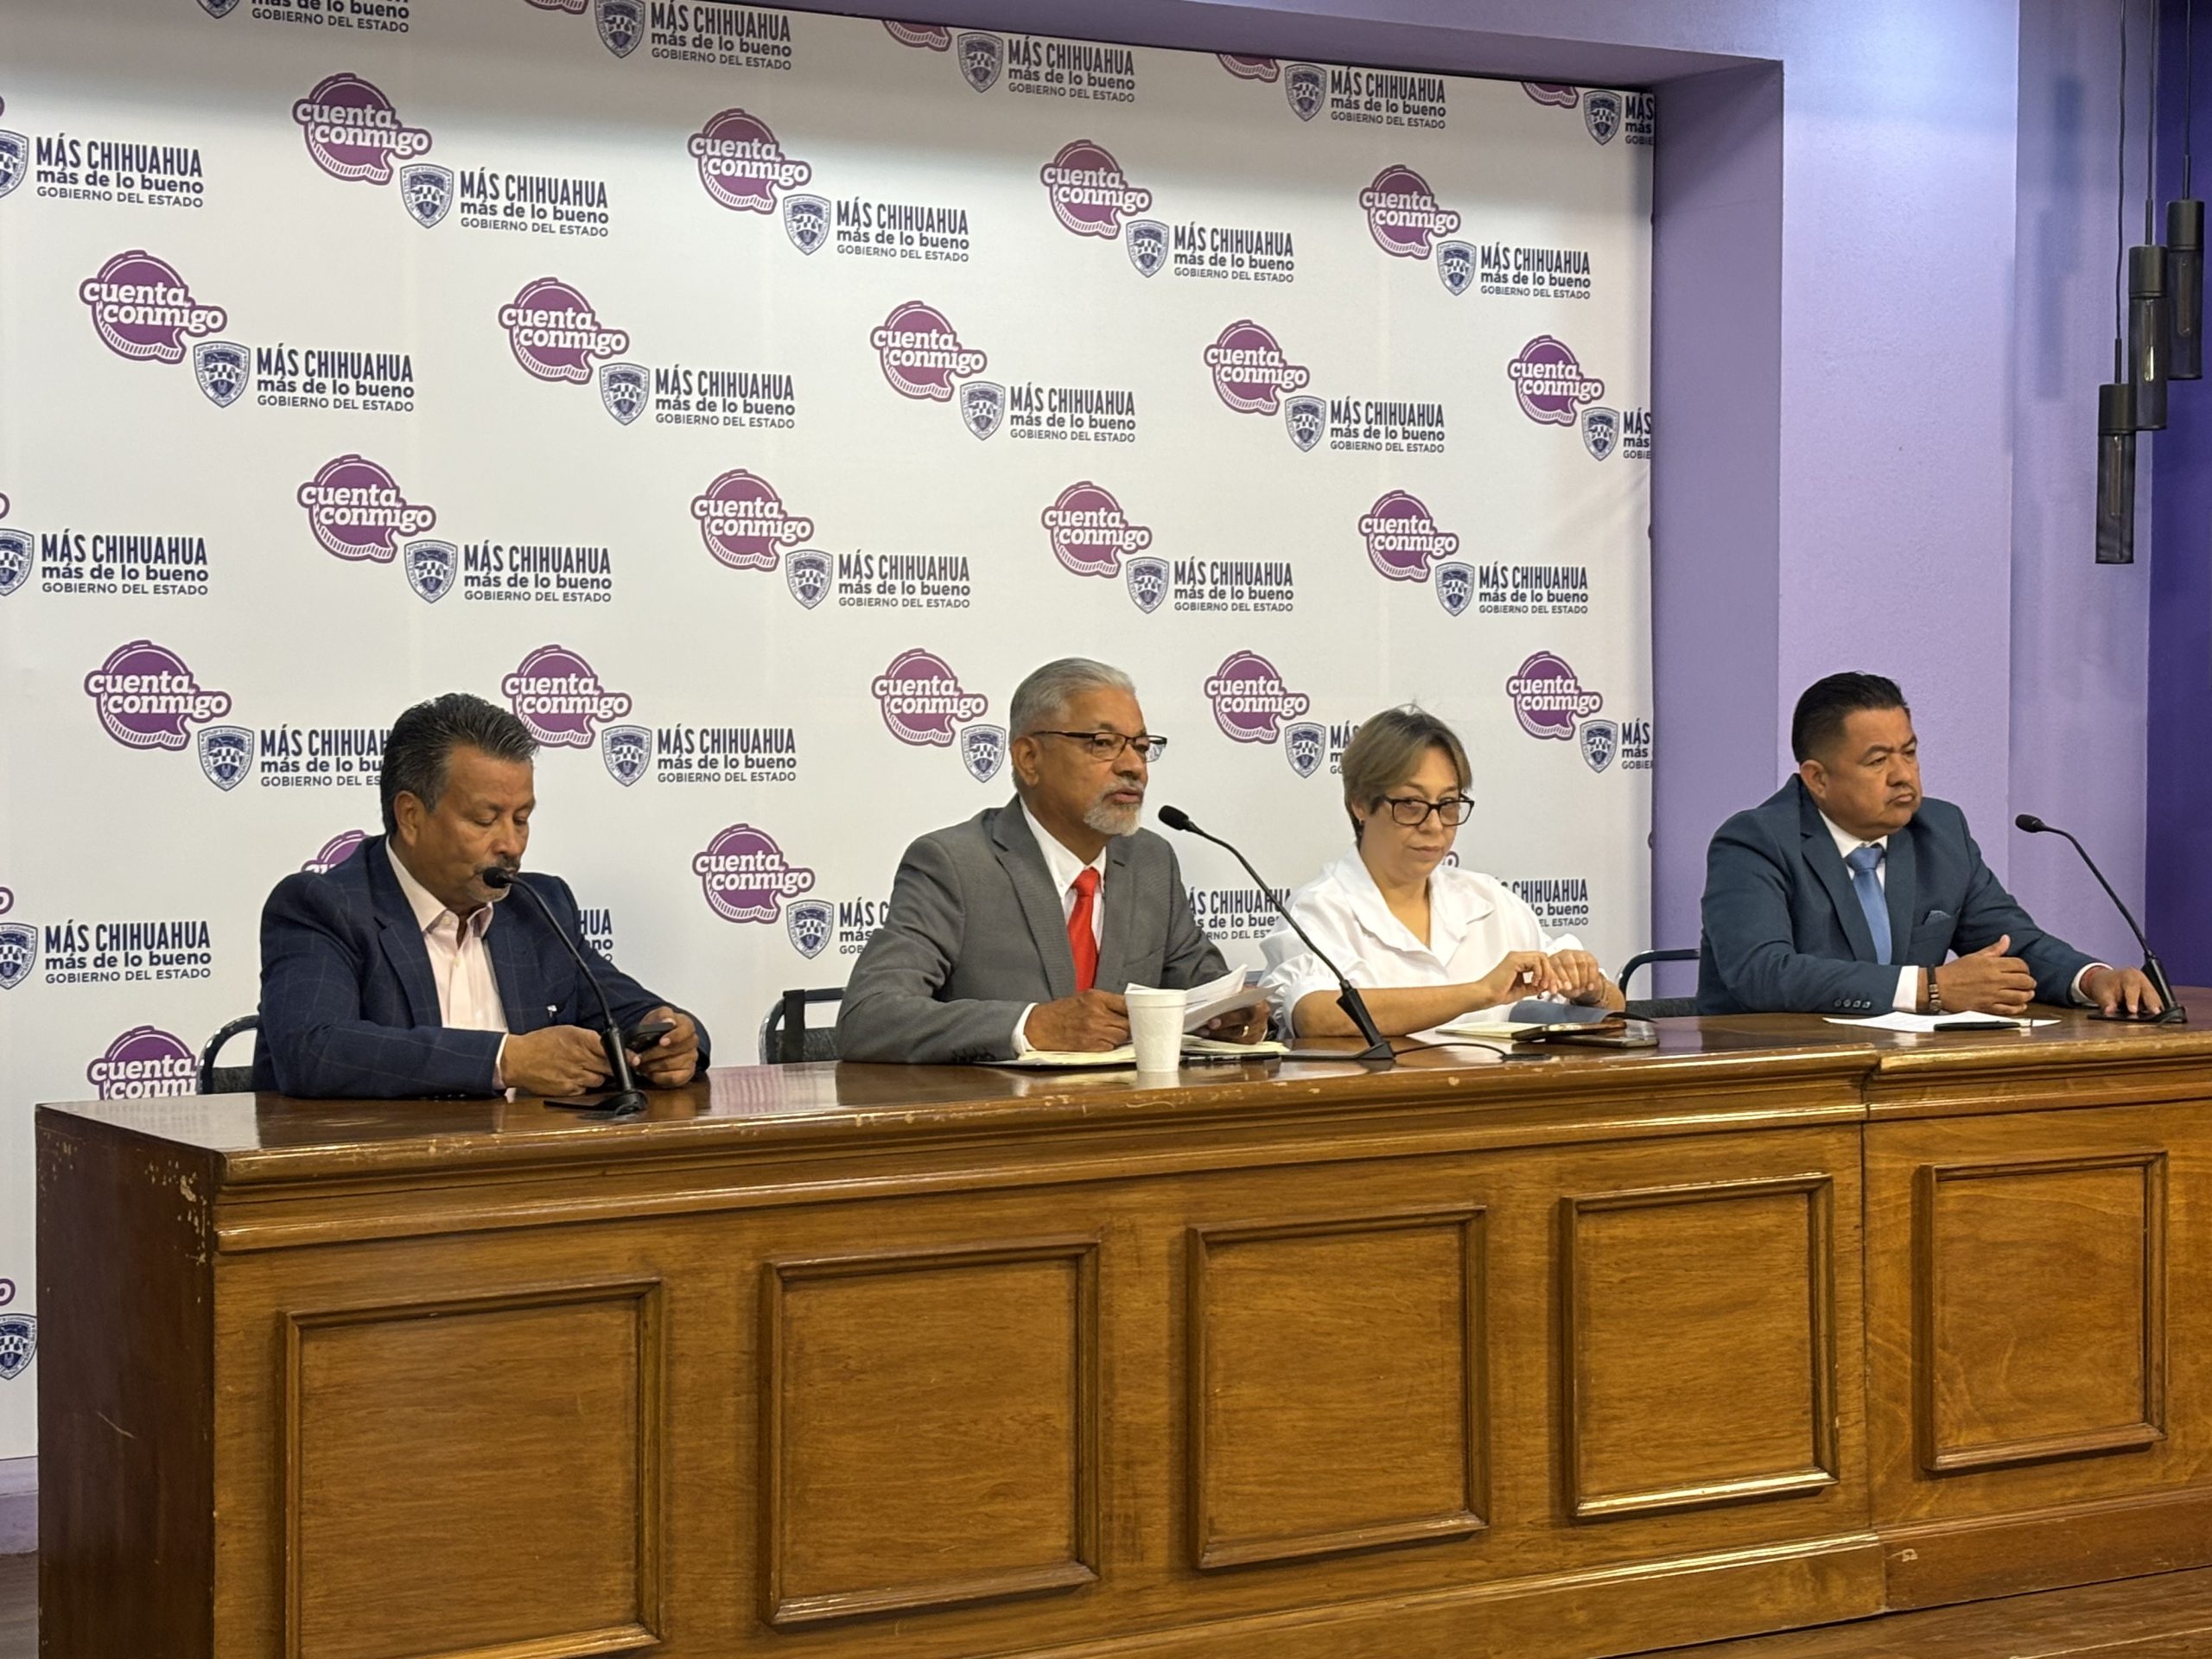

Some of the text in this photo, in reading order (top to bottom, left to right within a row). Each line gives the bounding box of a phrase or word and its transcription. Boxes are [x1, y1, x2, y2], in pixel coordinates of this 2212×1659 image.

[251, 8, 410, 33] GOBIERNO DEL ESTADO
[1007, 35, 1134, 76] MÁS CHIHUAHUA
[1008, 66, 1135, 90] más de lo bueno
[1008, 82, 1135, 103] GOBIERNO DEL ESTADO
[296, 104, 392, 128] cuenta
[315, 125, 429, 155] conmigo
[691, 137, 777, 160] cuenta
[36, 132, 80, 168] MÁS
[87, 141, 201, 177] CHIHUAHUA
[36, 167, 203, 194] más de lo bueno
[708, 158, 808, 186] conmigo
[1044, 167, 1121, 188] cuenta
[37, 186, 202, 208] GOBIERNO DEL ESTADO
[1058, 187, 1149, 212] conmigo
[1362, 191, 1432, 211] cuenta
[836, 196, 872, 228] MÁS
[877, 203, 968, 235] CHIHUAHUA
[1376, 209, 1458, 233] conmigo
[836, 226, 969, 250] más de lo bueno
[837, 245, 969, 263] GOBIERNO DEL ESTADO
[1481, 241, 1590, 275] MÁS CHIHUAHUA
[1480, 269, 1590, 288] más de lo bueno
[84, 283, 185, 306] cuenta
[1480, 285, 1590, 300] GOBIERNO DEL ESTADO
[104, 304, 223, 333] conmigo
[502, 308, 592, 329] cuenta
[519, 327, 626, 355] conmigo
[874, 329, 954, 350] cuenta
[257, 342, 299, 377] MÁS
[305, 350, 413, 382] CHIHUAHUA
[889, 348, 983, 373] conmigo
[1206, 346, 1280, 366] cuenta
[1221, 365, 1306, 389] conmigo
[1510, 360, 1577, 379] cuenta
[257, 376, 414, 398] más de lo bueno
[1522, 378, 1601, 401] conmigo
[257, 395, 414, 412] GOBIERNO DEL ESTADO
[1331, 396, 1444, 428] MÁS CHIHUAHUA
[1331, 423, 1445, 441] más de lo bueno
[1331, 441, 1444, 453] GOBIERNO DEL ESTADO
[302, 484, 397, 506] cuenta
[320, 505, 432, 532] conmigo
[695, 497, 779, 518] cuenta
[1045, 507, 1121, 527] cuenta
[710, 517, 810, 542] conmigo
[1361, 515, 1431, 534] cuenta
[41, 528, 86, 563] MÁS
[92, 535, 207, 565] CHIHUAHUA
[1059, 525, 1149, 550] conmigo
[1374, 532, 1456, 556] conmigo
[41, 562, 208, 582] más de lo bueno
[838, 549, 874, 580] MÁS
[879, 555, 969, 582] CHIHUAHUA
[1479, 561, 1587, 589] MÁS CHIHUAHUA
[42, 582, 207, 595] GOBIERNO DEL ESTADO
[838, 579, 970, 596] más de lo bueno
[1479, 588, 1588, 602] más de lo bueno
[839, 597, 969, 608] GOBIERNO DEL ESTADO
[1479, 605, 1587, 614] GOBIERNO DEL ESTADO
[88, 671, 190, 693] cuenta
[505, 673, 594, 694] cuenta
[874, 676, 955, 696] cuenta
[1207, 676, 1280, 696] cuenta
[1509, 676, 1575, 694] cuenta
[108, 691, 227, 718] conmigo
[523, 692, 628, 718] conmigo
[890, 693, 984, 718] conmigo
[1221, 693, 1306, 716] conmigo
[1522, 691, 1599, 714] conmigo
[261, 724, 302, 757] MÁS
[658, 723, 795, 754] MÁS CHIHUAHUA
[1622, 718, 1650, 745] MÁS
[261, 757, 300, 772] más
[306, 757, 330, 772] de
[335, 757, 353, 772] lo
[658, 753, 797, 769] más de lo bueno
[261, 776, 333, 787] GOBIERNO
[337, 776, 362, 786] DEL
[658, 772, 796, 783] GOBIERNO DEL ESTADO
[696, 850, 780, 873] cuenta
[712, 868, 811, 893] conmigo
[1548, 903, 1589, 916] bueno
[1552, 917, 1589, 927] ESTADO
[45, 919, 210, 953] MÁS CHIHUAHUA
[45, 950, 211, 969] más de lo bueno
[45, 968, 210, 984] GOBIERNO DEL ESTADO
[91, 1054, 193, 1080] cuenta
